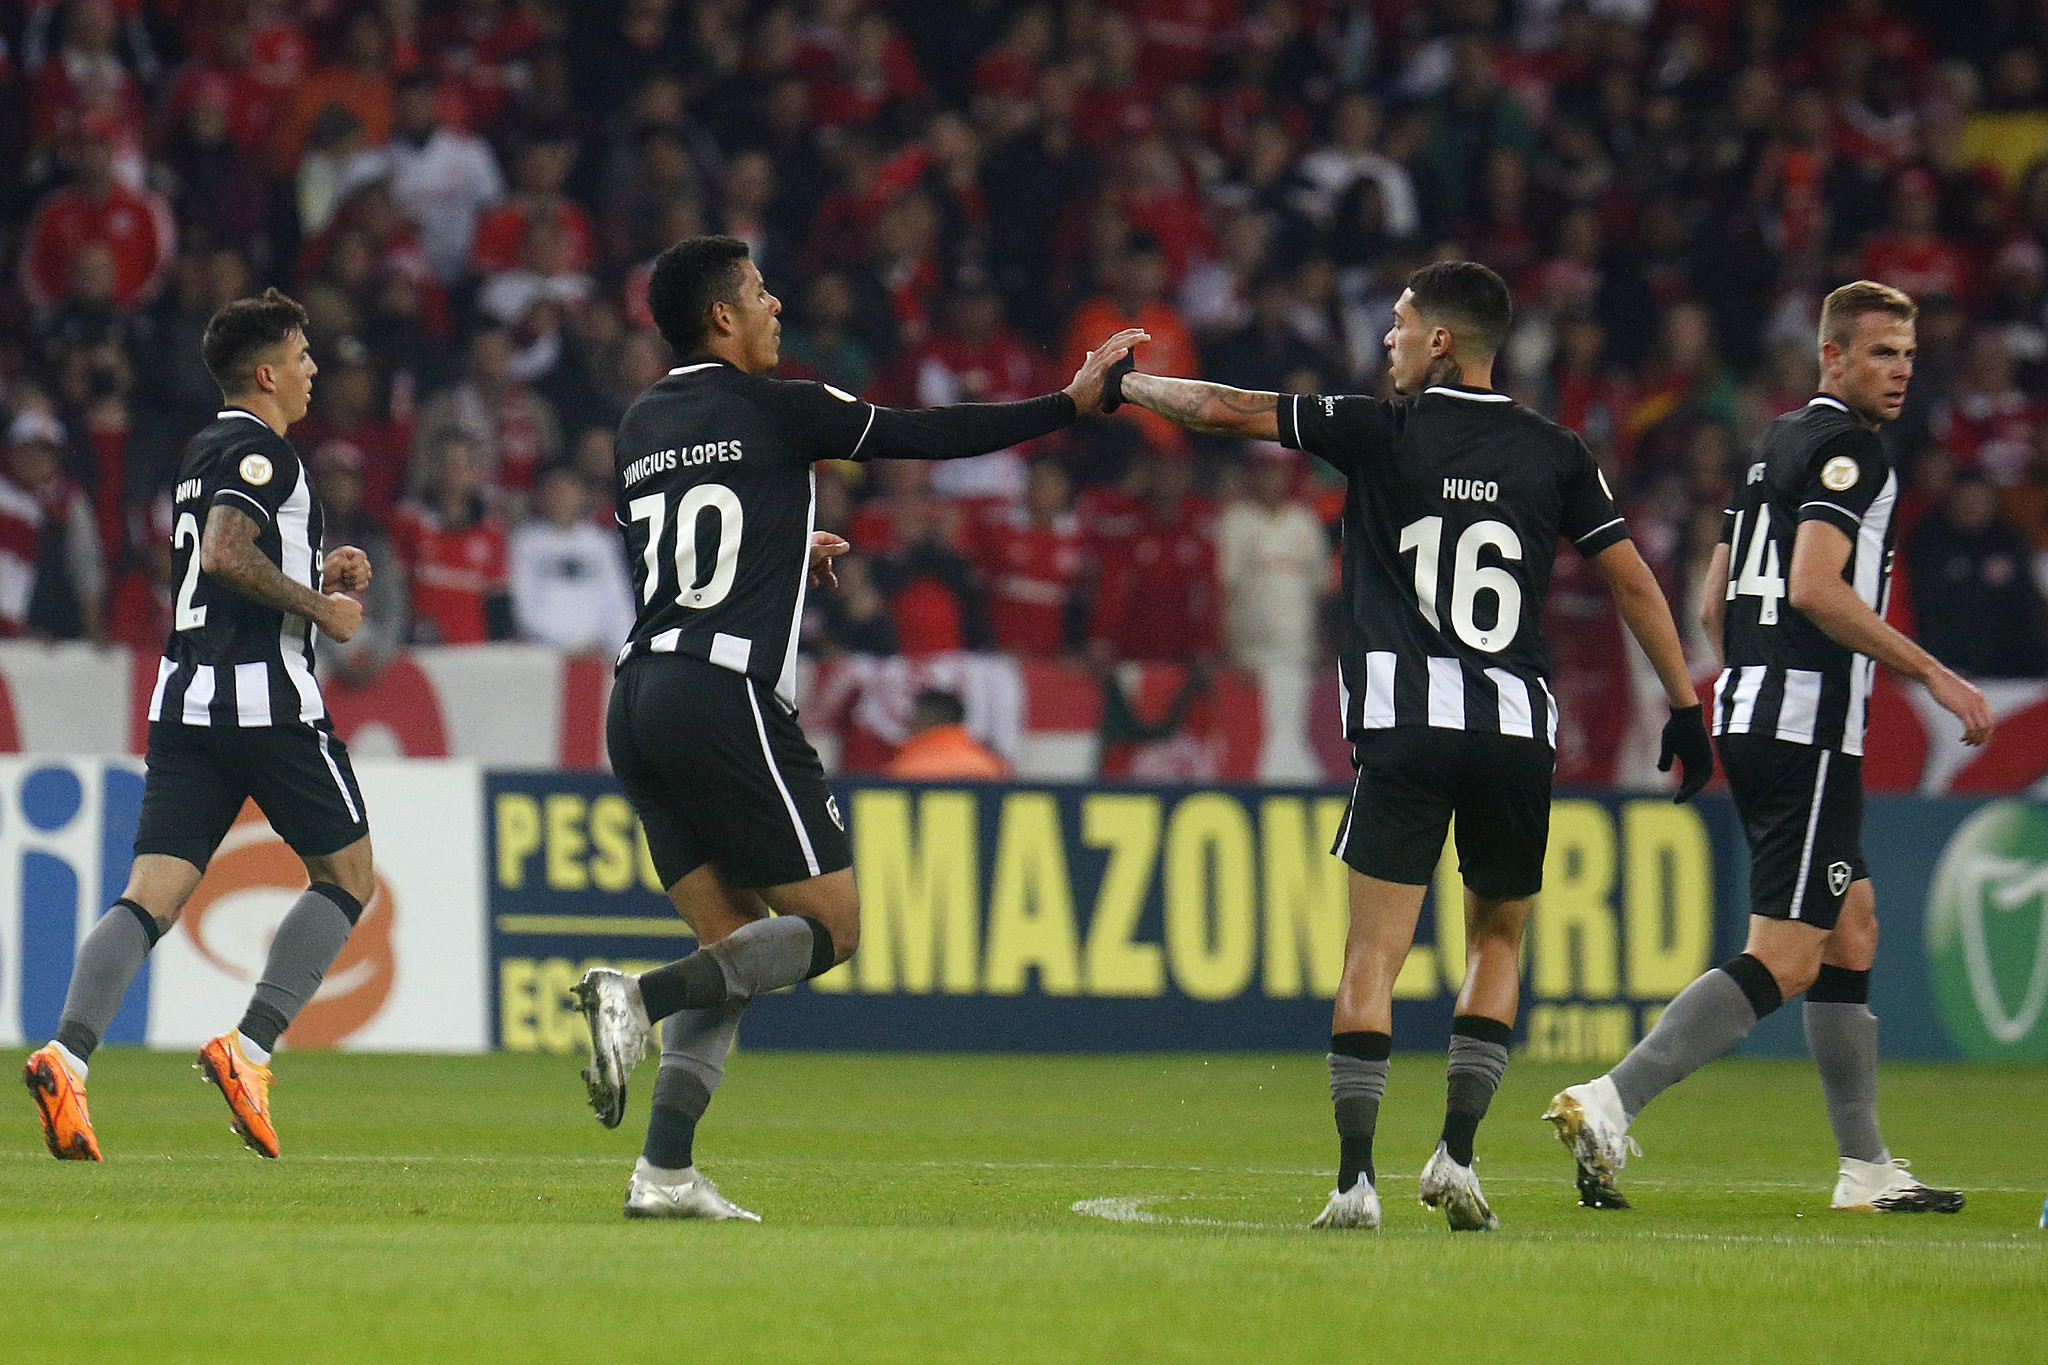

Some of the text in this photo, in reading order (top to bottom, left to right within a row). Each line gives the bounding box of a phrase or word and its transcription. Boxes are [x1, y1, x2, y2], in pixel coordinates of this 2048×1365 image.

[623, 439, 743, 489] VINICIUS LOPES
[1442, 478, 1499, 502] HUGO
[174, 512, 207, 632] 2
[629, 483, 744, 610] 70
[1399, 515, 1523, 653] 16
[757, 788, 1715, 1001] MAZONRD
